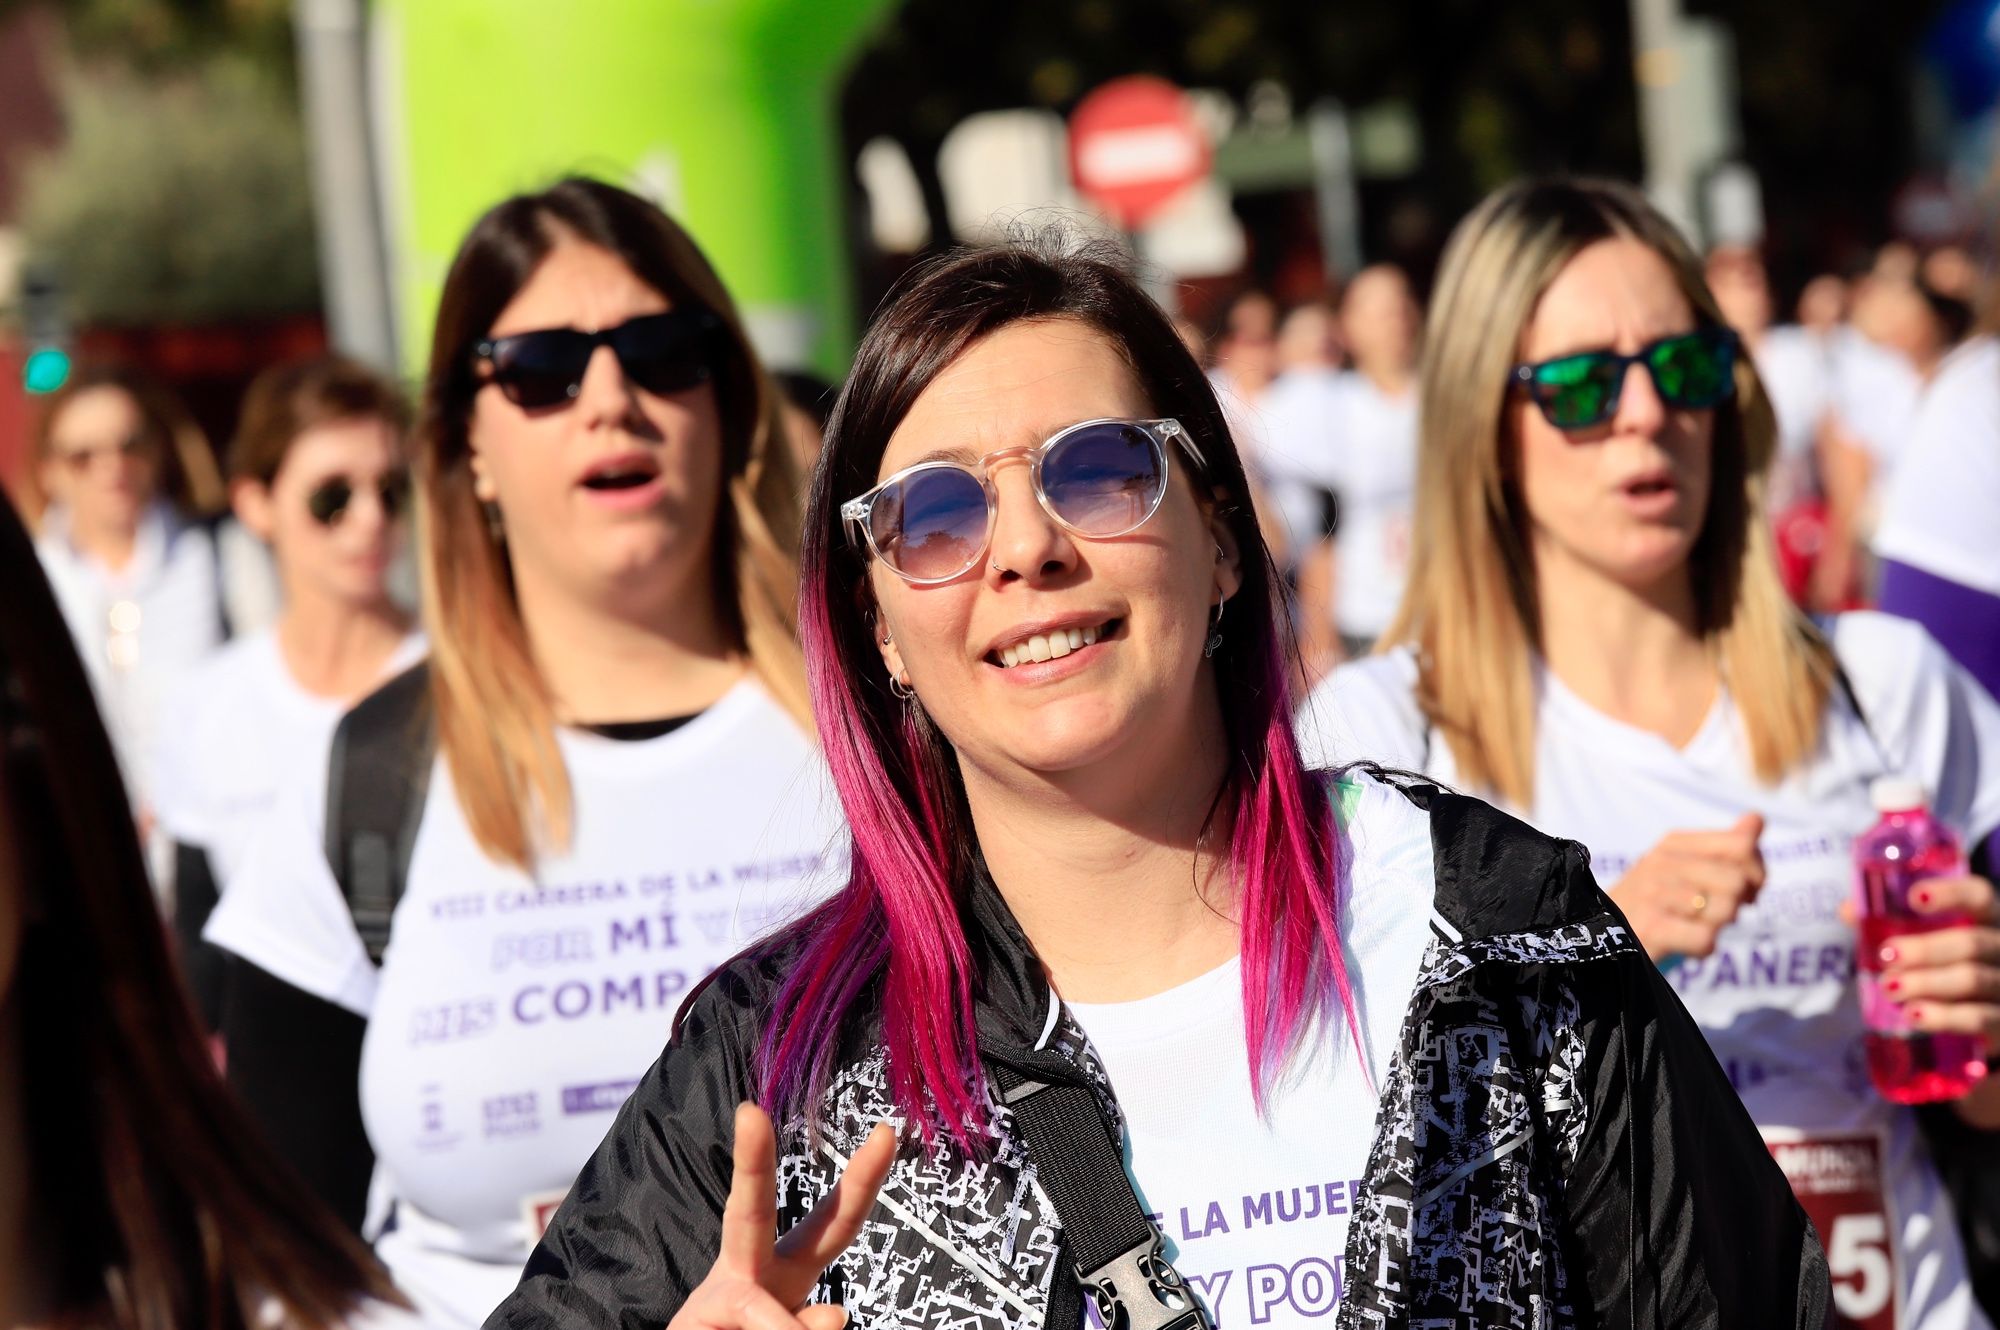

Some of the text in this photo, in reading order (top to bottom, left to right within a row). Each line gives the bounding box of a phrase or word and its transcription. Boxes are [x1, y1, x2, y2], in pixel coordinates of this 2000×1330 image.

[495, 879, 628, 914] CARRERA
[638, 874, 675, 898] DE
[686, 869, 723, 892] LA
[490, 928, 596, 972] POR
[511, 966, 708, 1025] COMP
[1179, 1200, 1231, 1241] LA
[1826, 1212, 1893, 1322] 5
